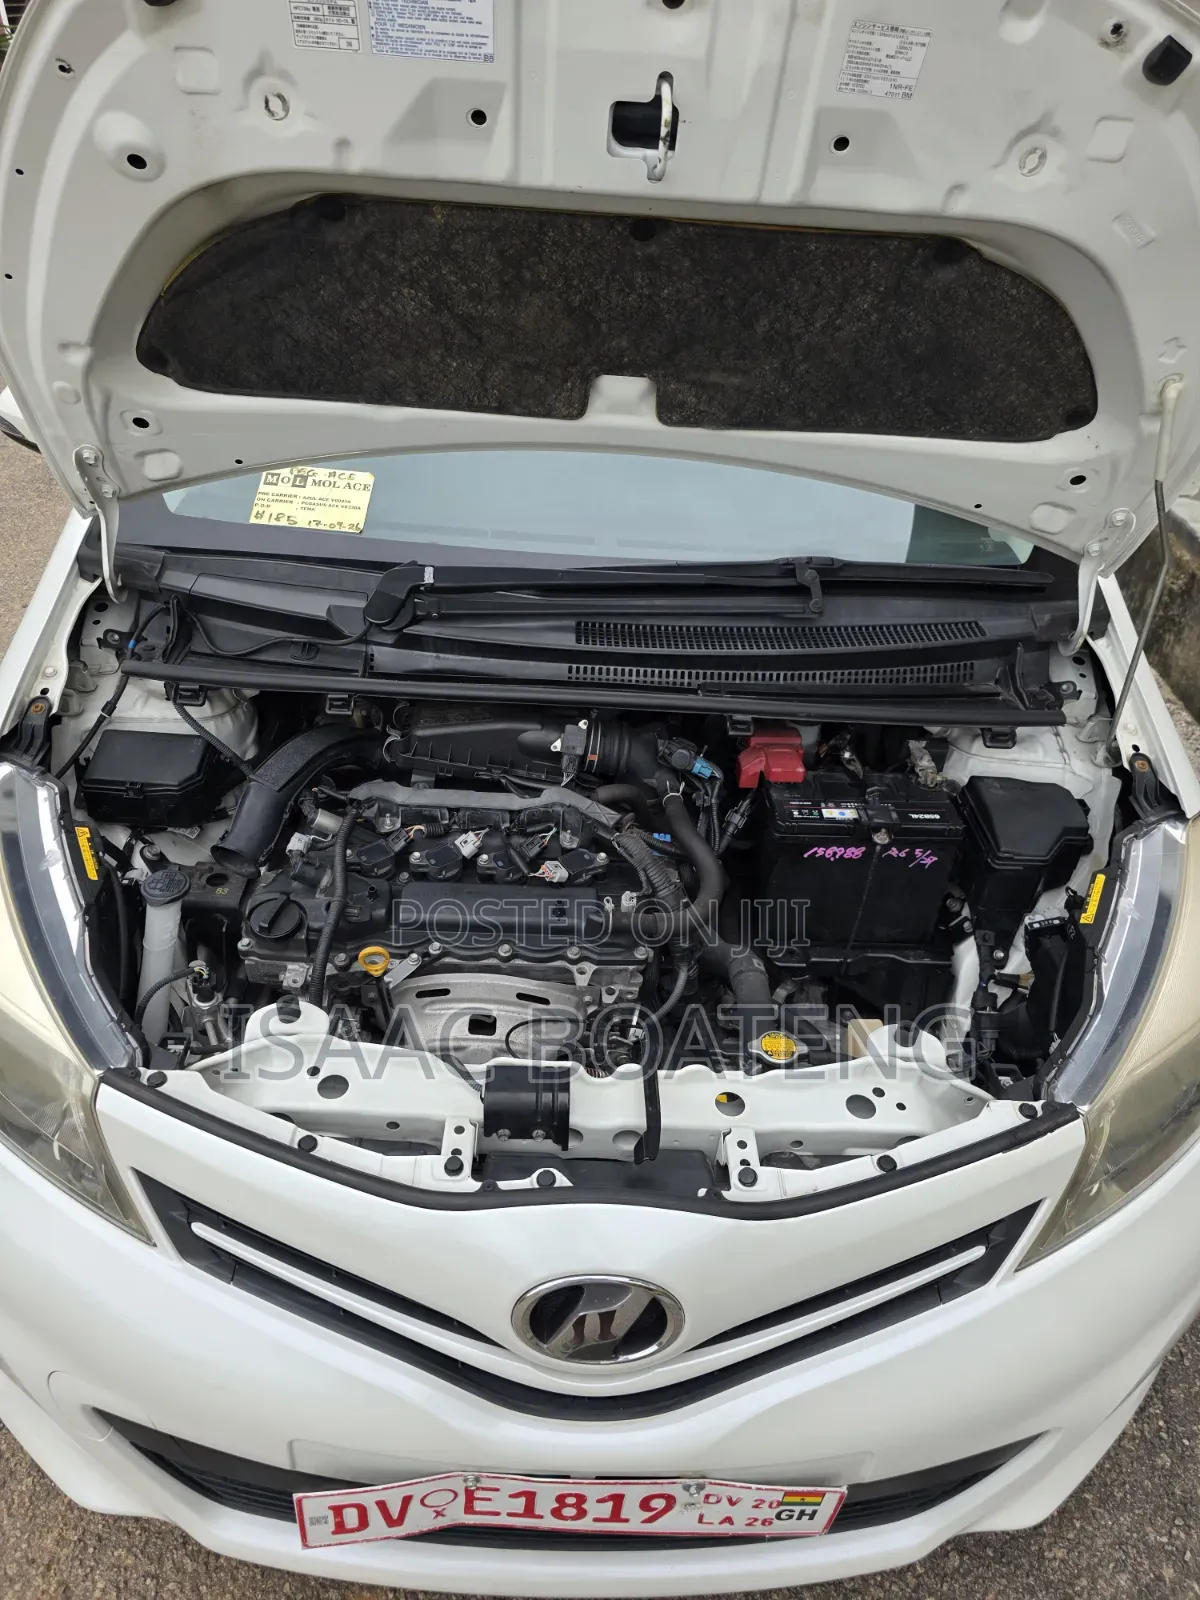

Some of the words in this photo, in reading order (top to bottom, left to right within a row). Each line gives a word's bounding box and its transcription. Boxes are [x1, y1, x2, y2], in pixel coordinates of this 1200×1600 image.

[889, 83, 914, 92] 1NR-FE
[310, 479, 341, 489] MOL
[343, 482, 371, 492] ACE
[703, 1493, 742, 1507] DV
[751, 1498, 781, 1509] 20
[328, 1494, 414, 1536] DV
[463, 1486, 677, 1524] E1819
[775, 1508, 818, 1521] GH
[697, 1512, 735, 1526] LA
[744, 1517, 774, 1527] 26
